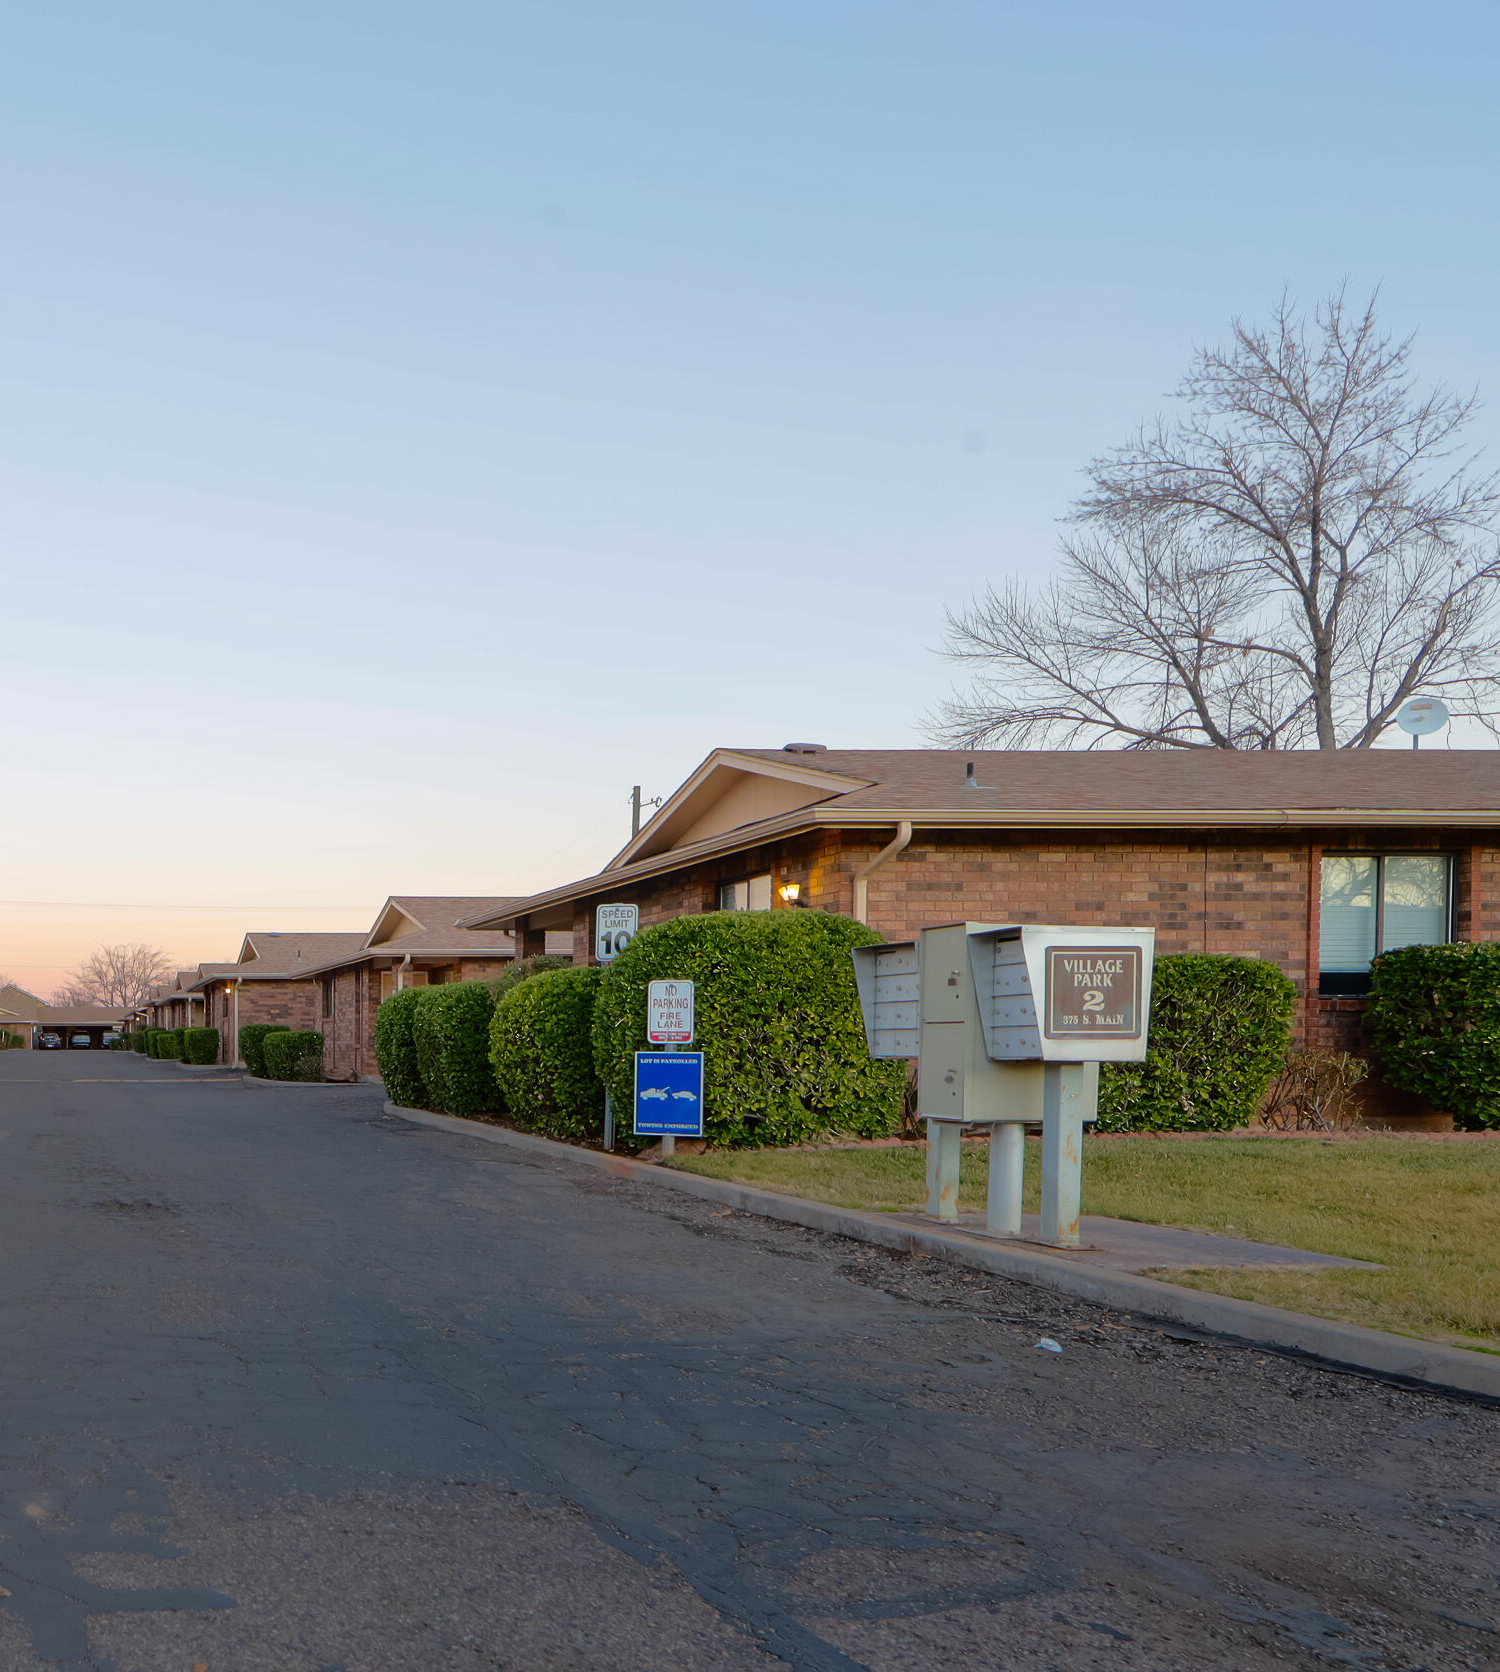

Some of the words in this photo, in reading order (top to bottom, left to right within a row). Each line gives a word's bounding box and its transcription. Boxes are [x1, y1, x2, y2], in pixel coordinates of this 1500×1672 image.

[602, 910, 634, 919] SPEED
[605, 920, 629, 928] LIMIT
[601, 931, 631, 954] 10
[1064, 960, 1123, 973] VILLAGE
[1074, 974, 1114, 987] PARK
[665, 986, 677, 996] NO
[653, 998, 689, 1009] PARKING
[1083, 991, 1105, 1011] 2
[660, 1012, 681, 1020] FIRE
[1063, 1016, 1079, 1025] 375
[657, 1021, 684, 1029] LANE
